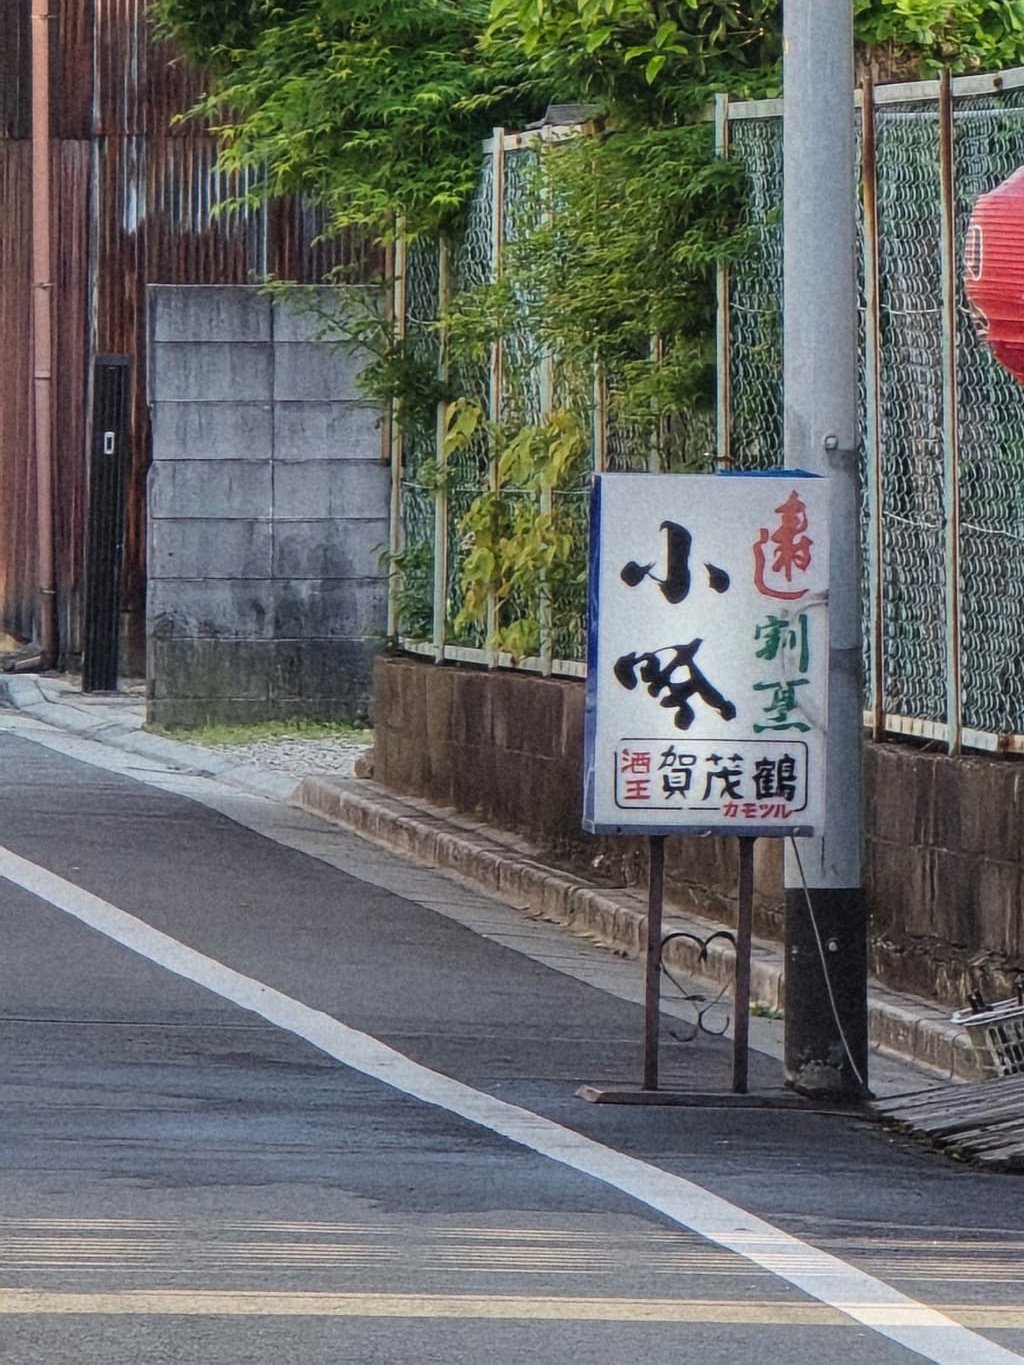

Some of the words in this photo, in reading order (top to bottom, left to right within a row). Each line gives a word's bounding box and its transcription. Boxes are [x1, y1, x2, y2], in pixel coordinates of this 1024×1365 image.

[753, 613, 811, 733] 割烹
[620, 748, 651, 801] 酒王
[657, 745, 797, 802] 賀茂鶴
[722, 801, 793, 819] カモツル
